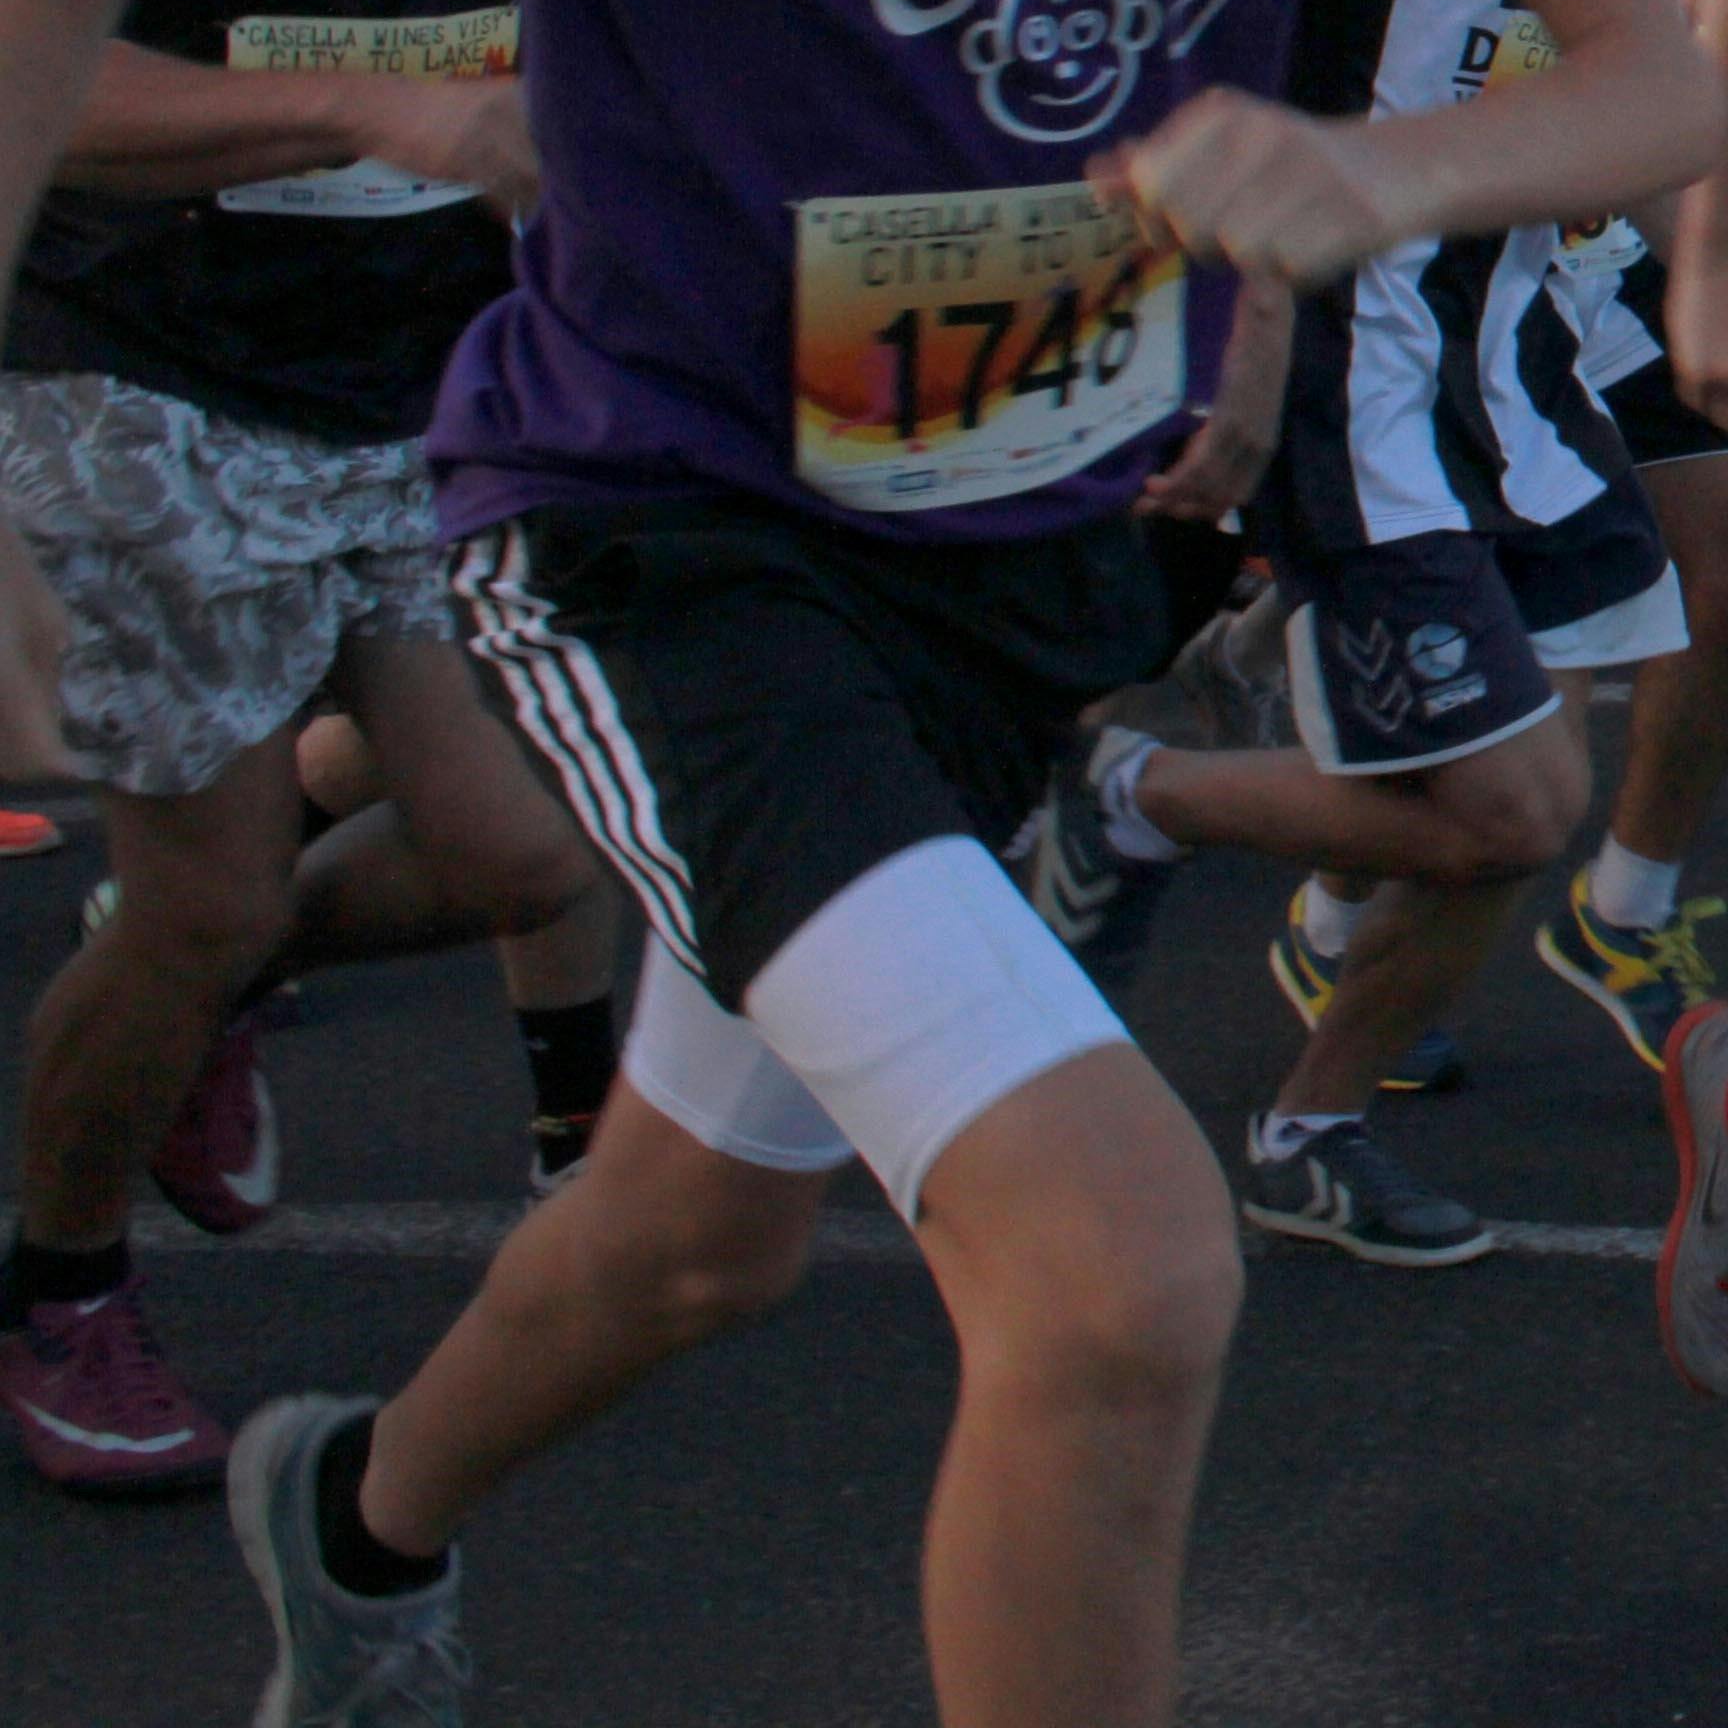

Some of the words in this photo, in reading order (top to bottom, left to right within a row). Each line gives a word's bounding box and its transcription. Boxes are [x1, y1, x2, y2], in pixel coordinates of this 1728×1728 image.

[249, 25, 357, 49] CASELLA
[373, 23, 446, 49] WINES
[458, 14, 502, 40] VISY
[268, 49, 345, 72] CITY
[370, 50, 405, 72] TO
[423, 38, 486, 73] LAKE
[863, 241, 984, 287] CITY
